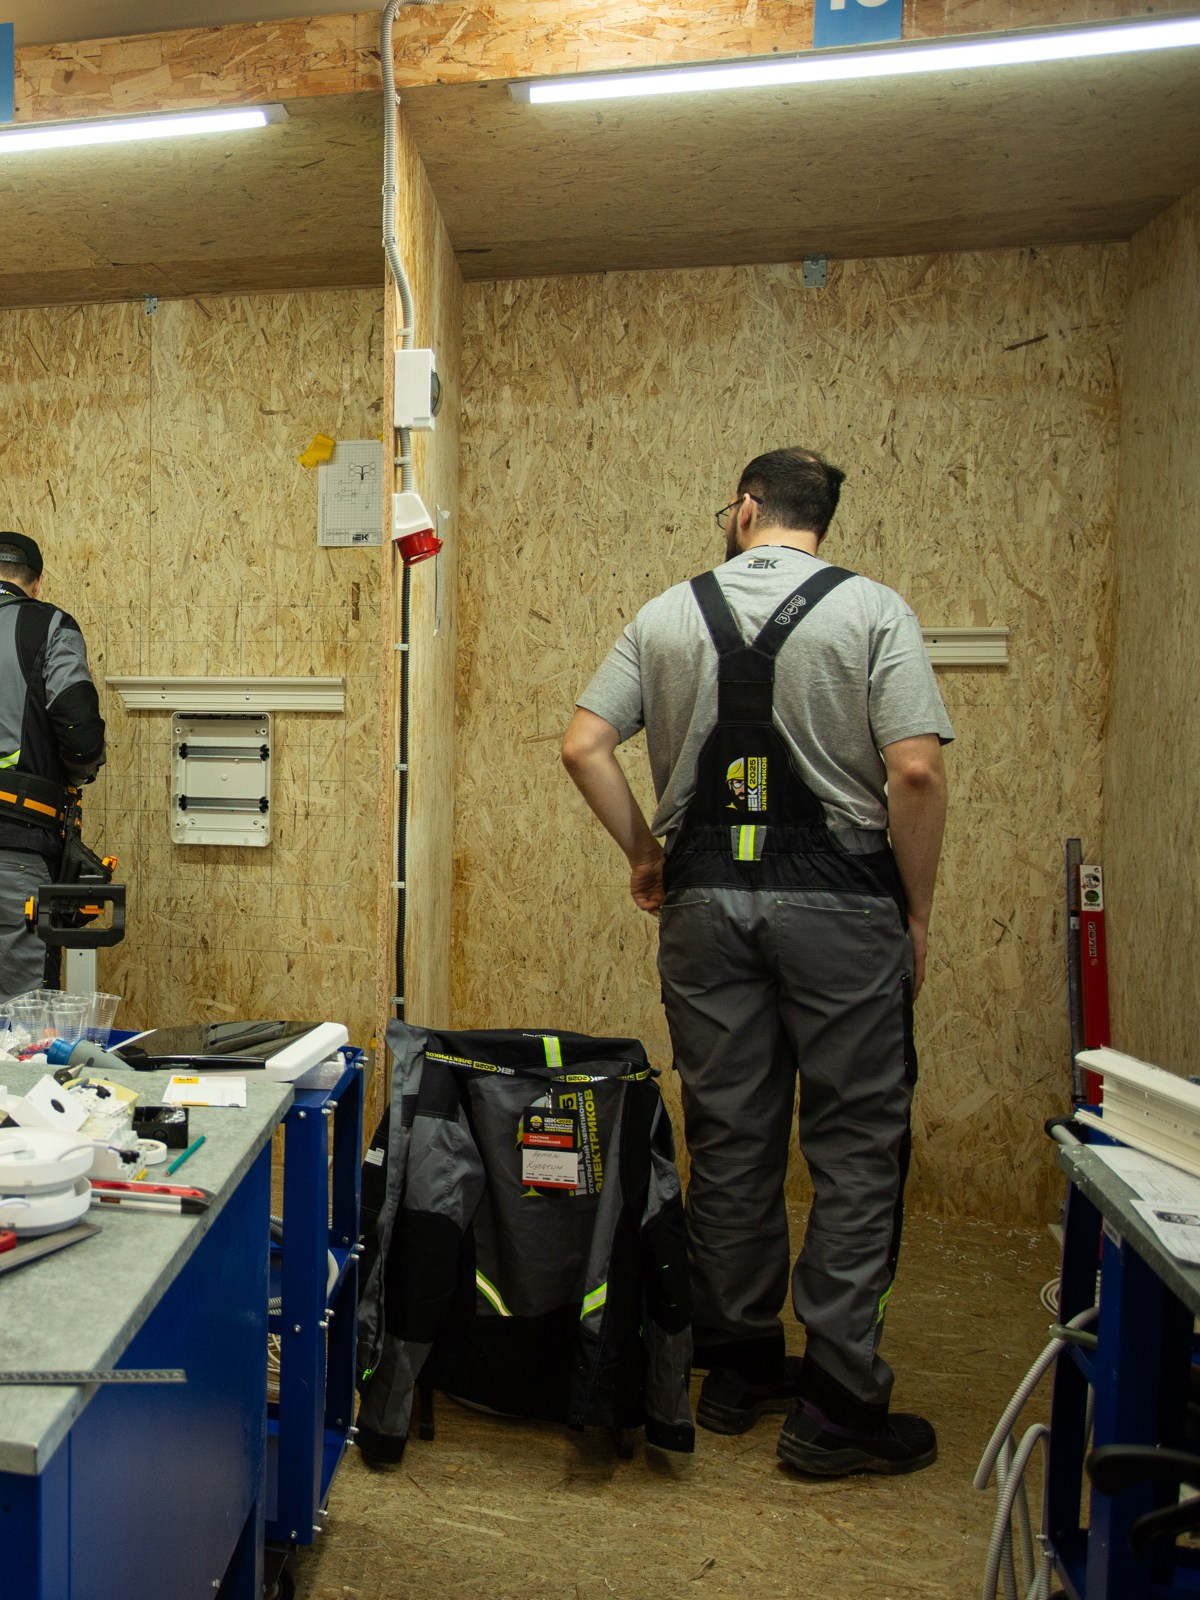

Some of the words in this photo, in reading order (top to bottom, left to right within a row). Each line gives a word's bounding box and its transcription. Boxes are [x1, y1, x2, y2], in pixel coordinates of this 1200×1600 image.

[425, 1051, 473, 1065] ЭЛЕКТРИКОВ
[475, 1062, 495, 1071] 2025
[577, 1091, 589, 1144] ЧЕМПИОНАТ
[584, 1088, 604, 1193] ЭЛЕКТРИКОВ
[582, 1145, 595, 1194] ОТКРЫТЫЙ
